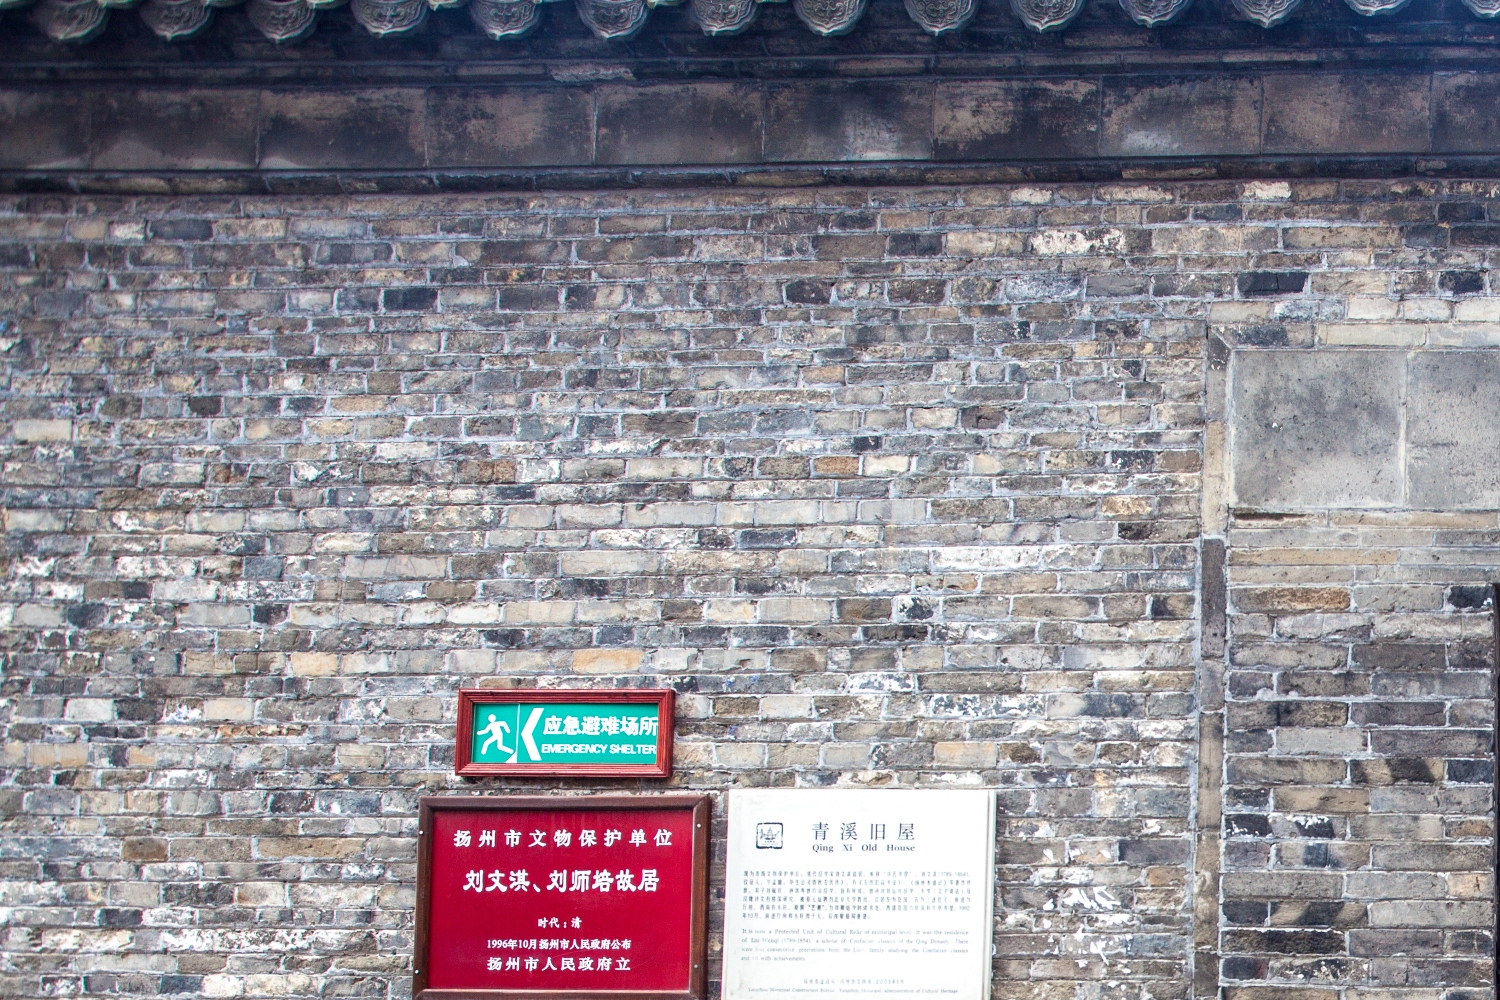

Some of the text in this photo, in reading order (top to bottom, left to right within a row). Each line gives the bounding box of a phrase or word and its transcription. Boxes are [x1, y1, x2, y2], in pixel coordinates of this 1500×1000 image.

[542, 715, 659, 736] 应急避难场所
[541, 743, 657, 755] EMERGENCY SHELTER
[453, 829, 673, 848] 扬州市文物保护单位
[811, 821, 915, 841] 青溪旧屋
[812, 843, 916, 853] Qing Xi Old House
[463, 868, 660, 893] 刘文淇、刘师培故居
[486, 938, 632, 950] 1996年10月扬州市人民政府公布
[486, 956, 632, 972] 扬州市人民政府立
